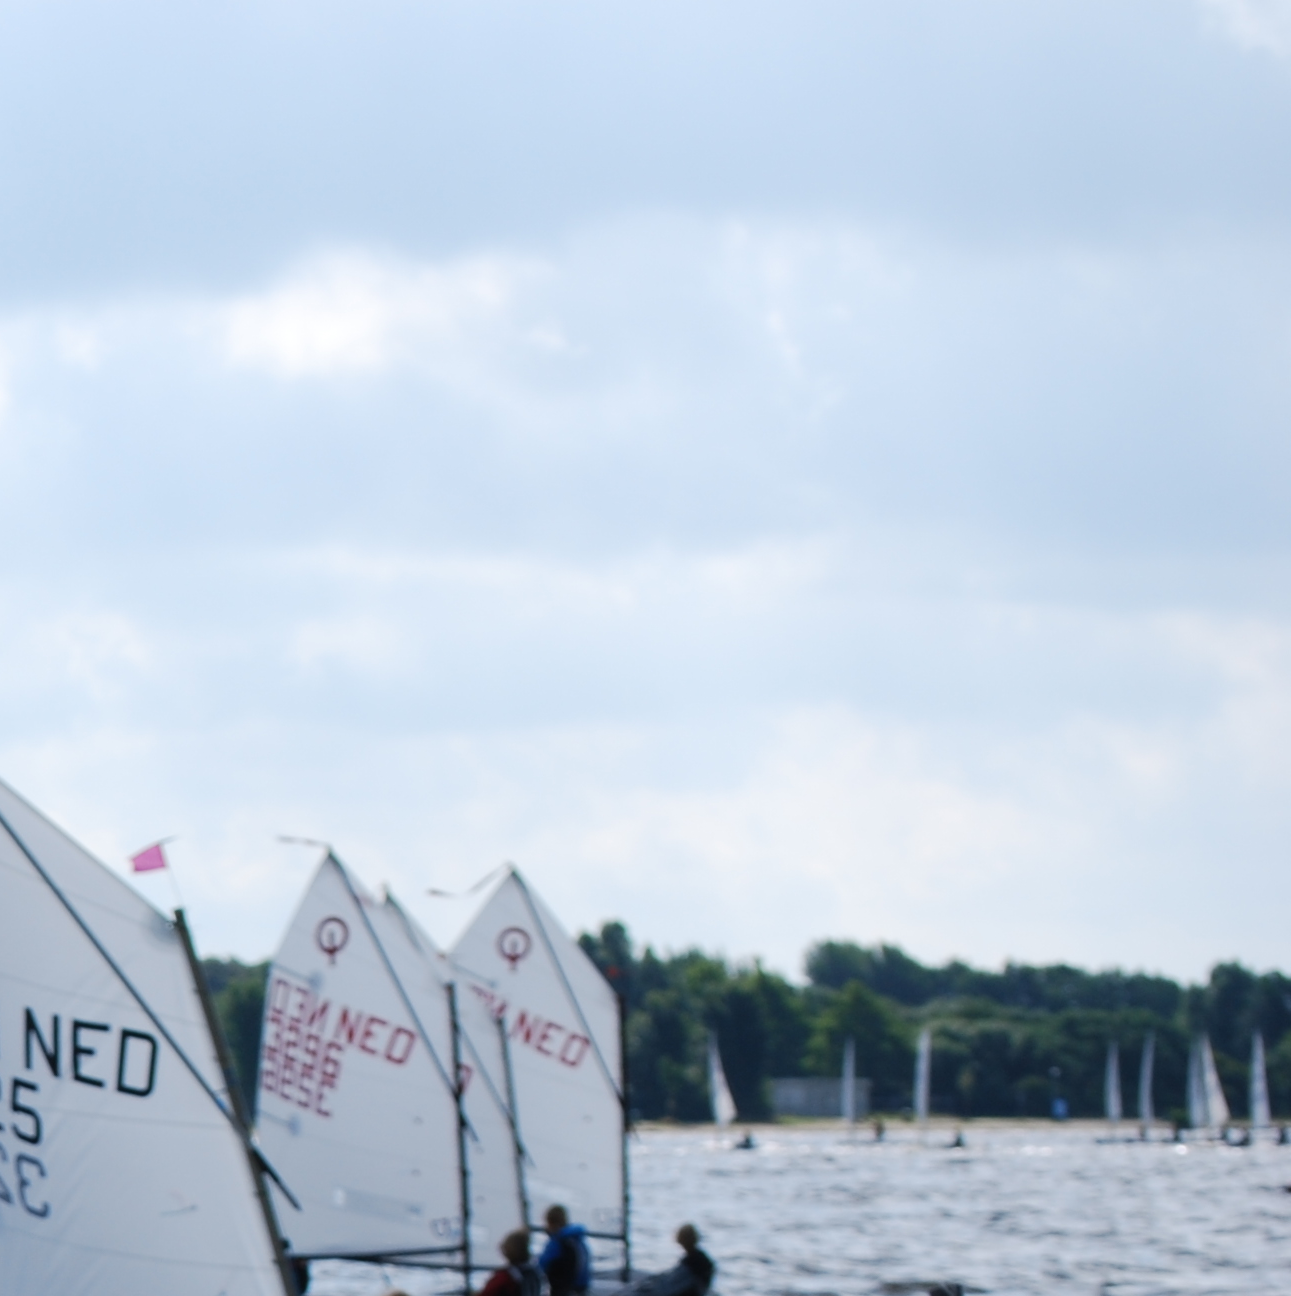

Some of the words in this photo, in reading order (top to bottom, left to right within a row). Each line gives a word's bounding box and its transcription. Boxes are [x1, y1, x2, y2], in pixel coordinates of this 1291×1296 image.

[24, 1006, 159, 1098] NED
[336, 1006, 418, 1066] NED
[508, 1009, 591, 1068] NED
